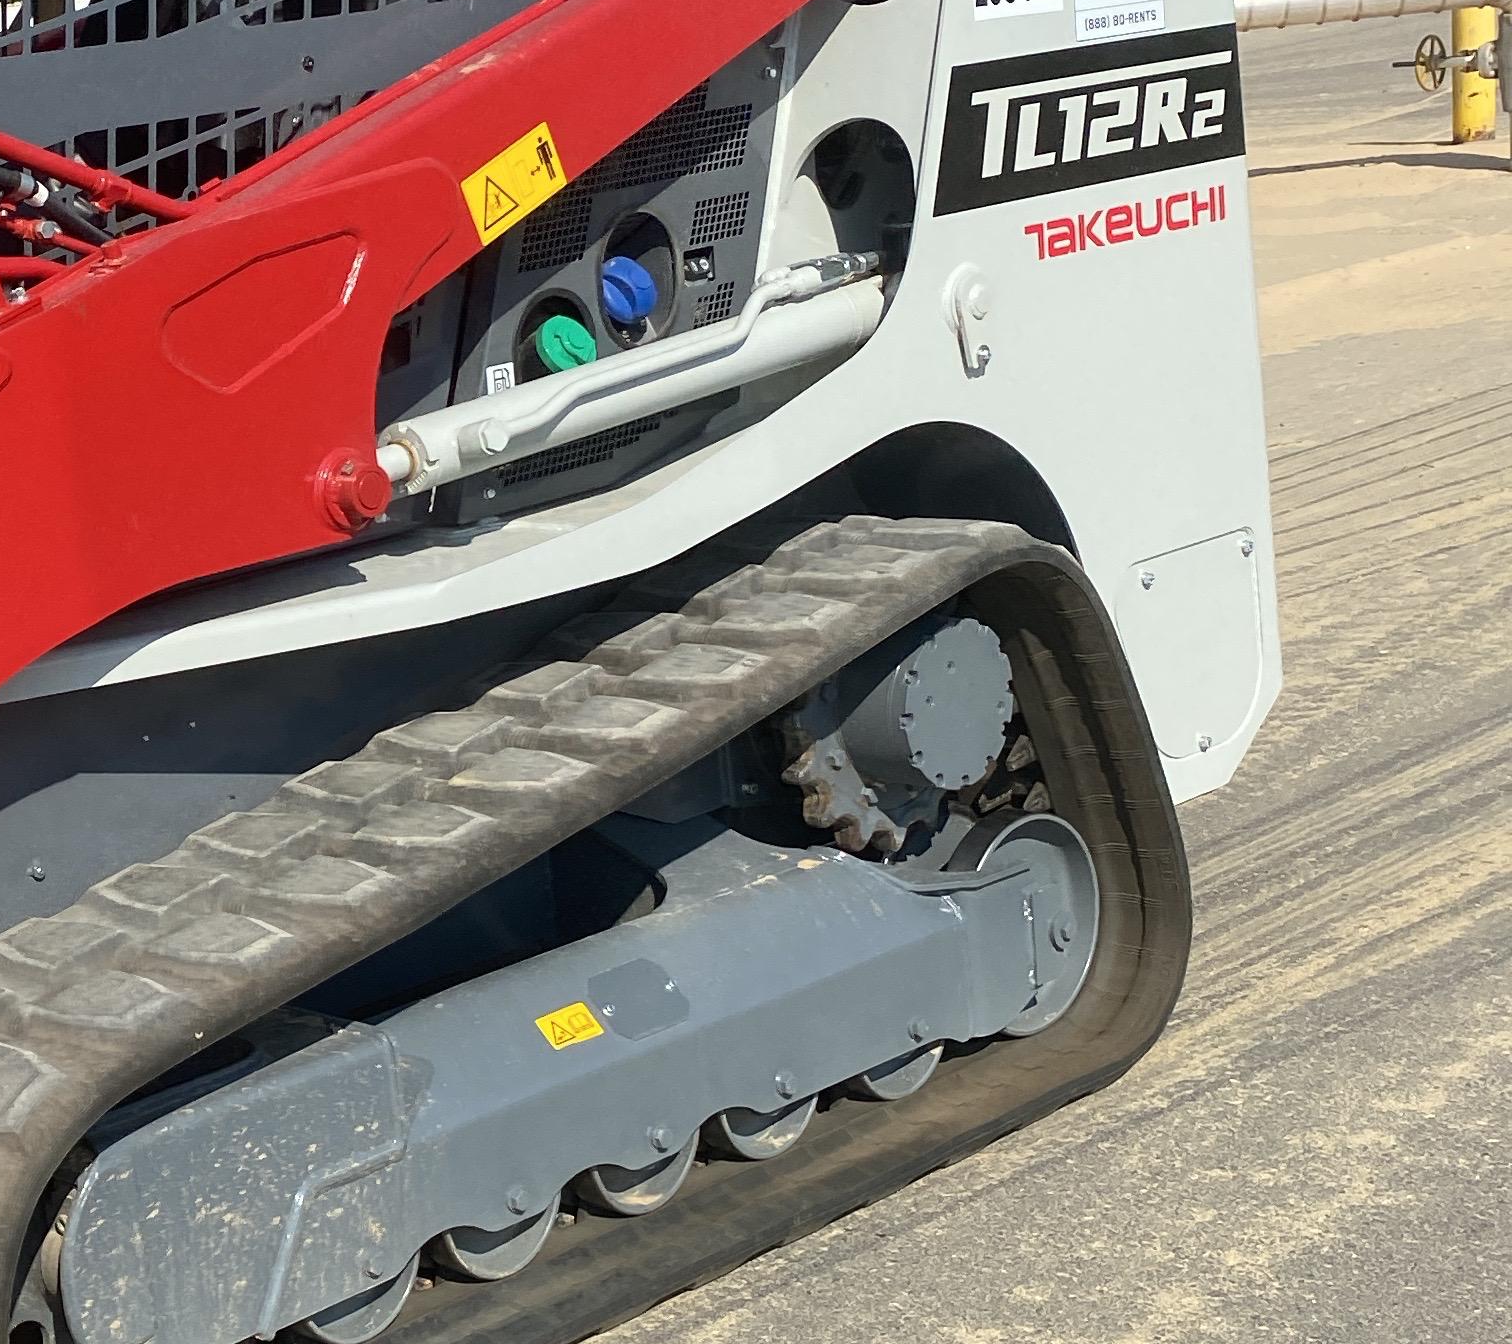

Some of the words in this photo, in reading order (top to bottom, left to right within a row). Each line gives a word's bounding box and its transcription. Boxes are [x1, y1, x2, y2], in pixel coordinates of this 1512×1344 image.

[1084, 16, 1110, 32] (888)
[971, 50, 1233, 179] TL12R2
[1024, 184, 1226, 260] TAKEUCHI
